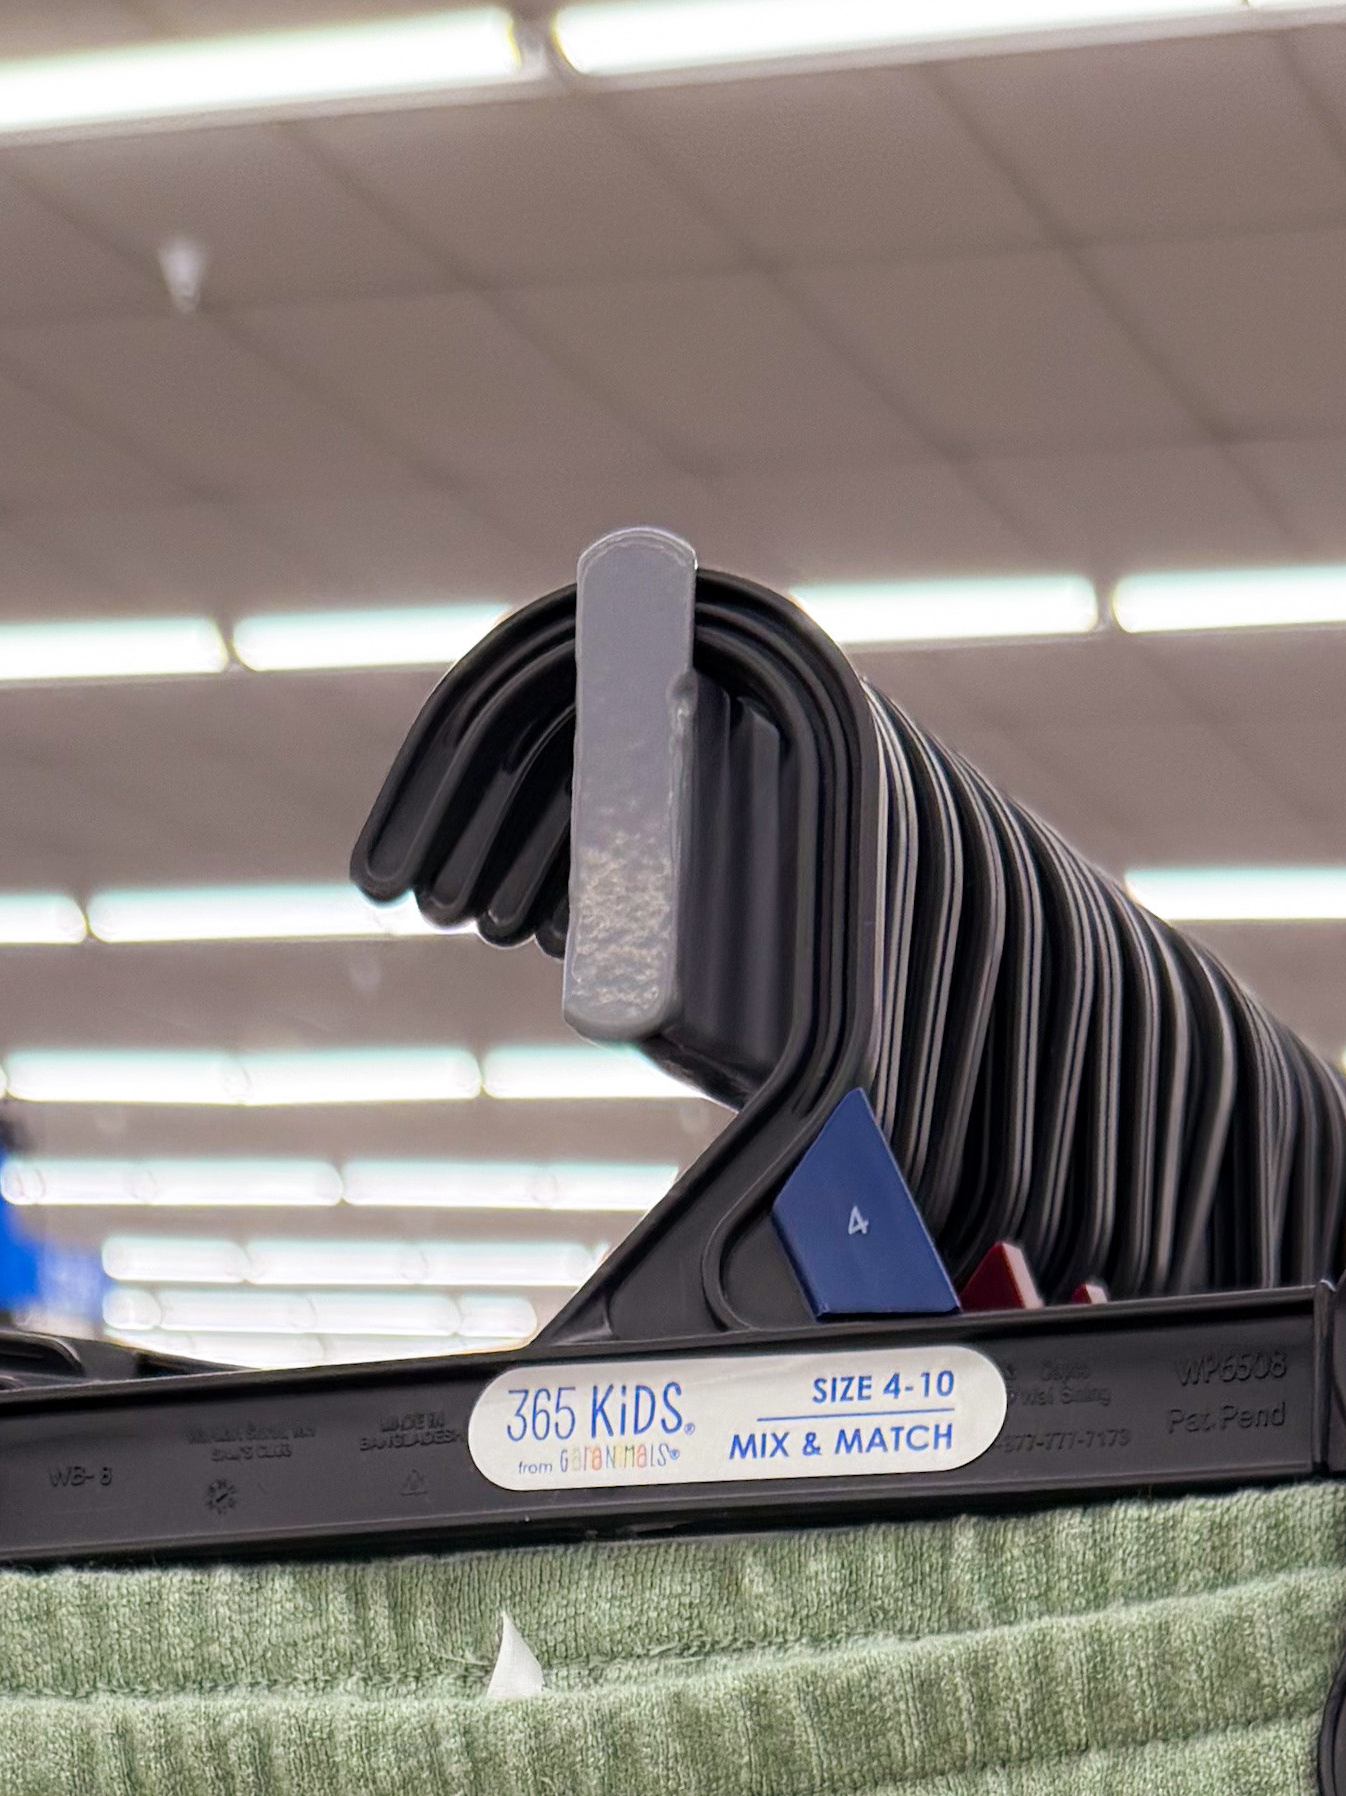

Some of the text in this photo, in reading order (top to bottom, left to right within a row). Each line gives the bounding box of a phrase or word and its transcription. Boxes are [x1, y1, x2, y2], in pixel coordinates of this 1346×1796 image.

[848, 1205, 869, 1235] 4
[811, 1369, 956, 1404] SIZE 4-10
[506, 1386, 577, 1442] 365
[728, 1423, 955, 1461] MIX & MATCH
[517, 1459, 554, 1475] from
